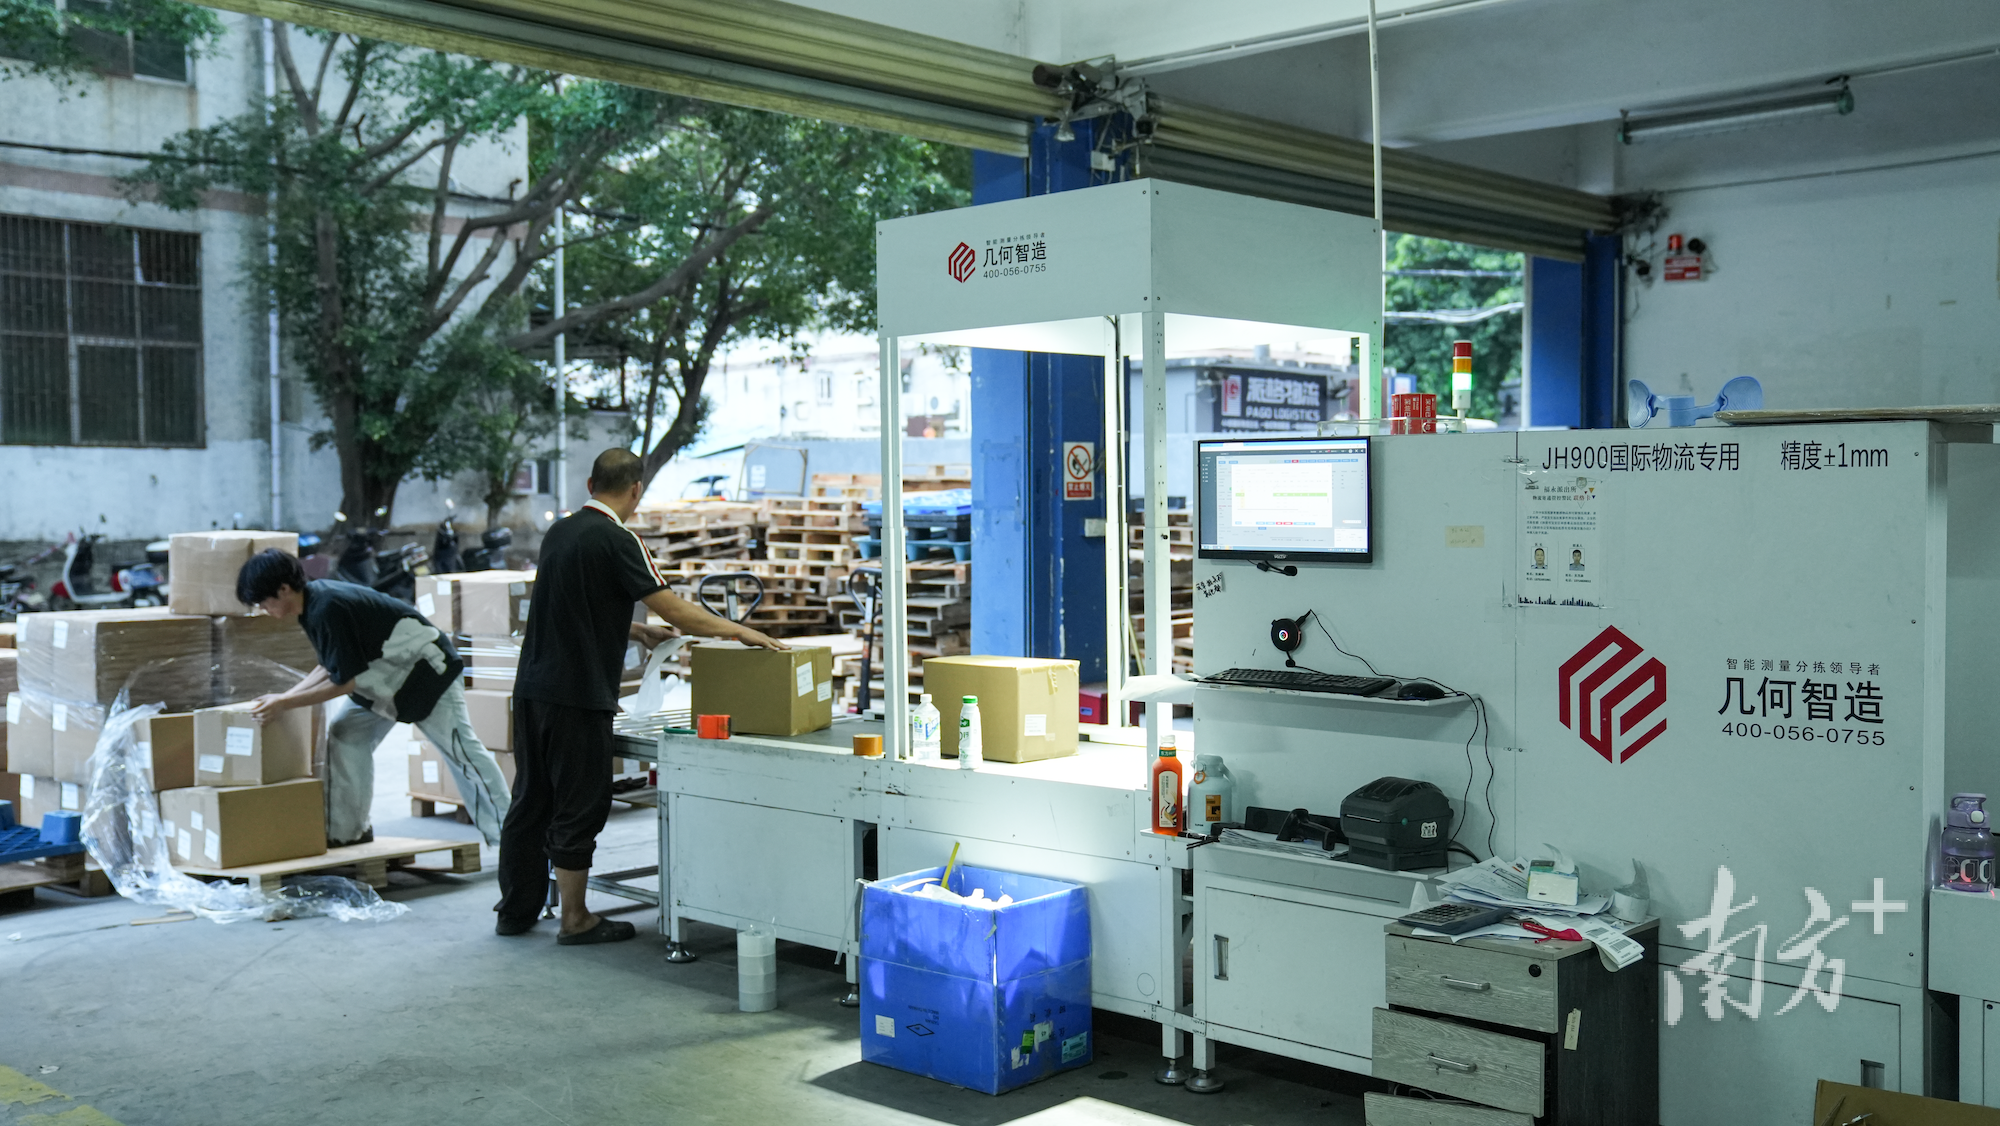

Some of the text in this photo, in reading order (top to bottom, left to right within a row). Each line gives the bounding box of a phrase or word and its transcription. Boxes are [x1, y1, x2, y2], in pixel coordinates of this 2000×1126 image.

[986, 232, 1046, 246] 智能测量分拣领导者
[983, 240, 1047, 268] 几何智造
[983, 263, 1047, 279] 400-056-0755
[1246, 405, 1321, 422] PAGO LOGISTICS
[1542, 442, 1740, 472] JH900国际物流专用
[1780, 440, 1889, 471] 精度±1mm
[1726, 657, 1881, 676] 智能测量分拣领导者
[1718, 676, 1885, 724] 几何智造
[1721, 722, 1886, 746] 400-056-0755
